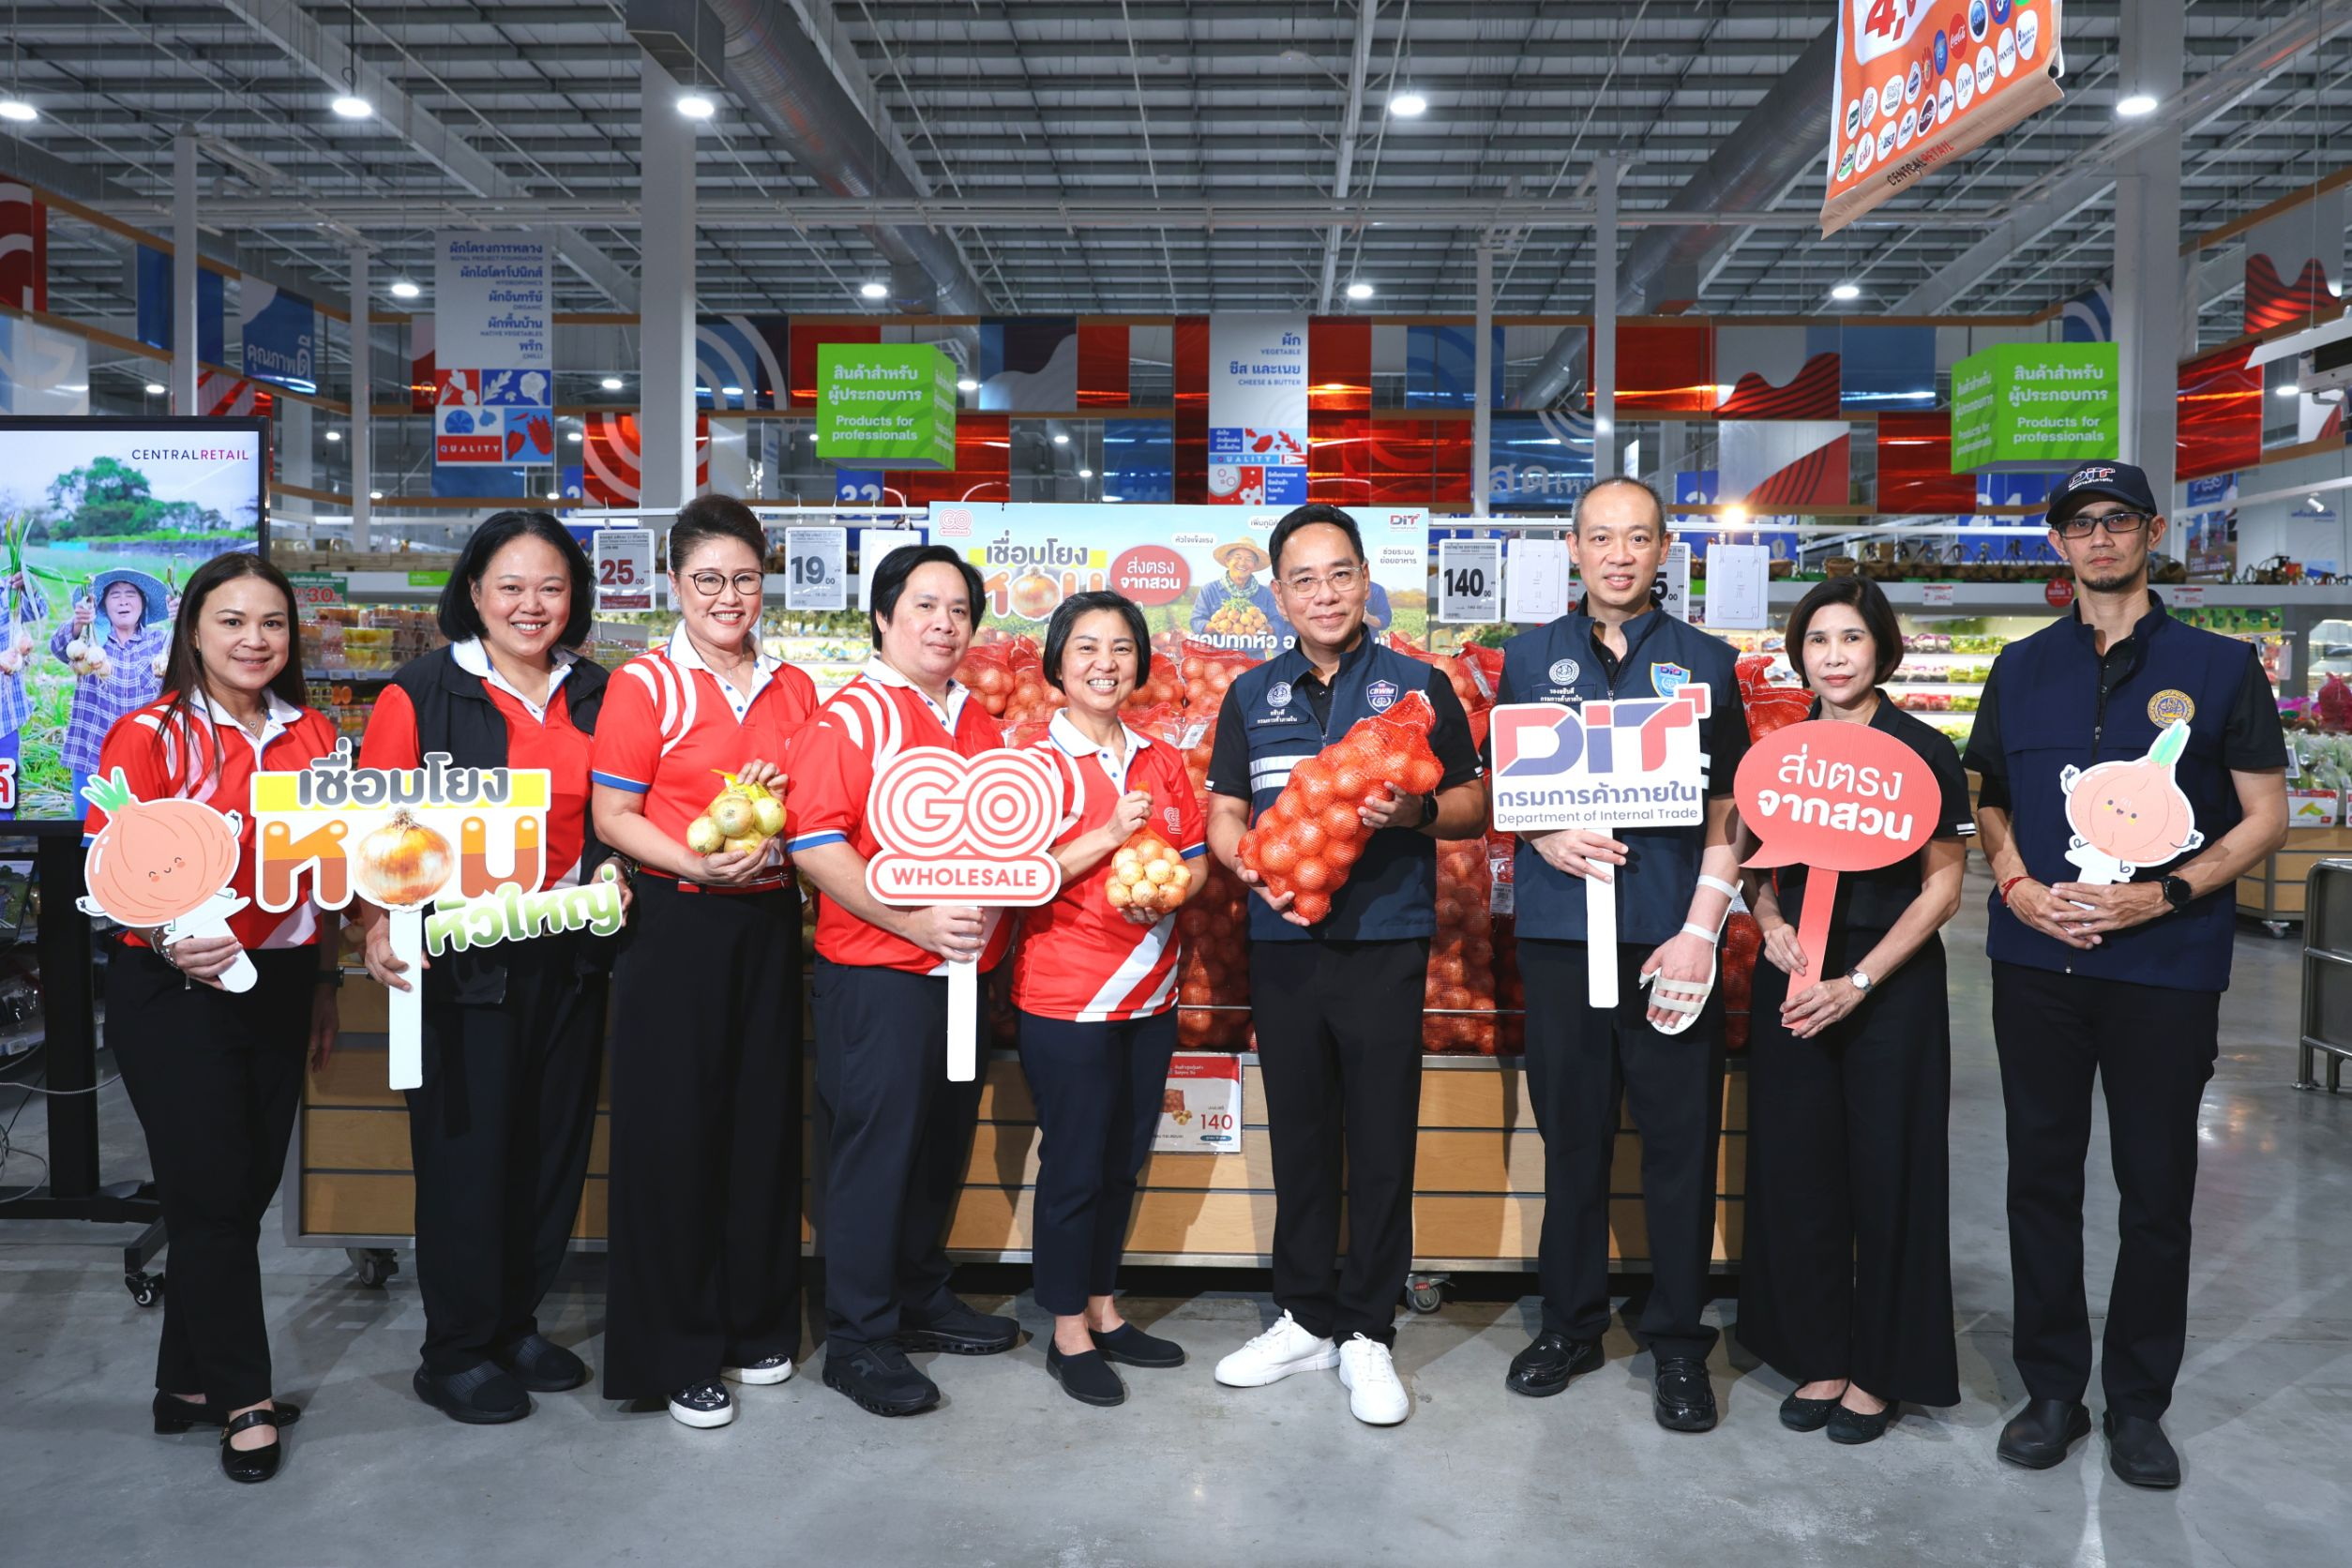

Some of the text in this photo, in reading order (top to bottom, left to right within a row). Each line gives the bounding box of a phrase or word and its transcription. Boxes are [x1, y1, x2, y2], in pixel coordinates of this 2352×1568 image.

[1865, 0, 1917, 41] 4,
[450, 241, 543, 253] ผักโครงการหลวง
[460, 265, 543, 278] ผักไฮโดรโปนิกส์
[489, 290, 543, 303] ผักอินทรีย์
[488, 313, 543, 329] ผักพื้นบ้าน
[519, 339, 543, 352] พริก
[1282, 331, 1302, 346] ผัก
[247, 335, 311, 380] คุณภาพดี
[834, 364, 919, 381] สินค้าสำหรับ
[1229, 360, 1301, 375] ชีส และเนย
[2014, 363, 2104, 382] สินค้าสำหรับ
[828, 384, 923, 406] ผู้ประกอบการ
[2008, 385, 2109, 408] ผู้ประกอบการ
[836, 415, 915, 427] Products for
[2017, 416, 2102, 429] Products for
[832, 430, 919, 442] professionals
[2013, 430, 2105, 445] professionals
[131, 448, 249, 460] CENTRALRETAIL
[440, 445, 500, 453] QUALITY
[1217, 455, 1272, 463] QUALITY
[986, 530, 1088, 565] เชื่อมโยง
[1175, 535, 1214, 545] หัวใจแข็งแรง
[1382, 547, 1415, 556] ช่วยระบบ
[1126, 557, 1175, 574] ส่งตรง
[1380, 556, 1417, 565] ย่อยอาหาร
[600, 559, 634, 585] 25
[791, 555, 825, 584] 19
[1120, 576, 1182, 590] จากสวน
[1444, 568, 1492, 597] 140 00
[299, 738, 508, 806] เชื่อมโยง
[1778, 744, 1903, 801] ส่งตรง
[1498, 780, 1697, 807] กรมการค้าภายใน
[873, 751, 1056, 862] GO
[1757, 789, 1913, 841] จากสวน
[1498, 807, 1698, 826] Department of Internal Trade
[892, 867, 1037, 887] WHOLESALE
[426, 864, 621, 957] หัวใหญ่
[1200, 1113, 1233, 1130] 140
